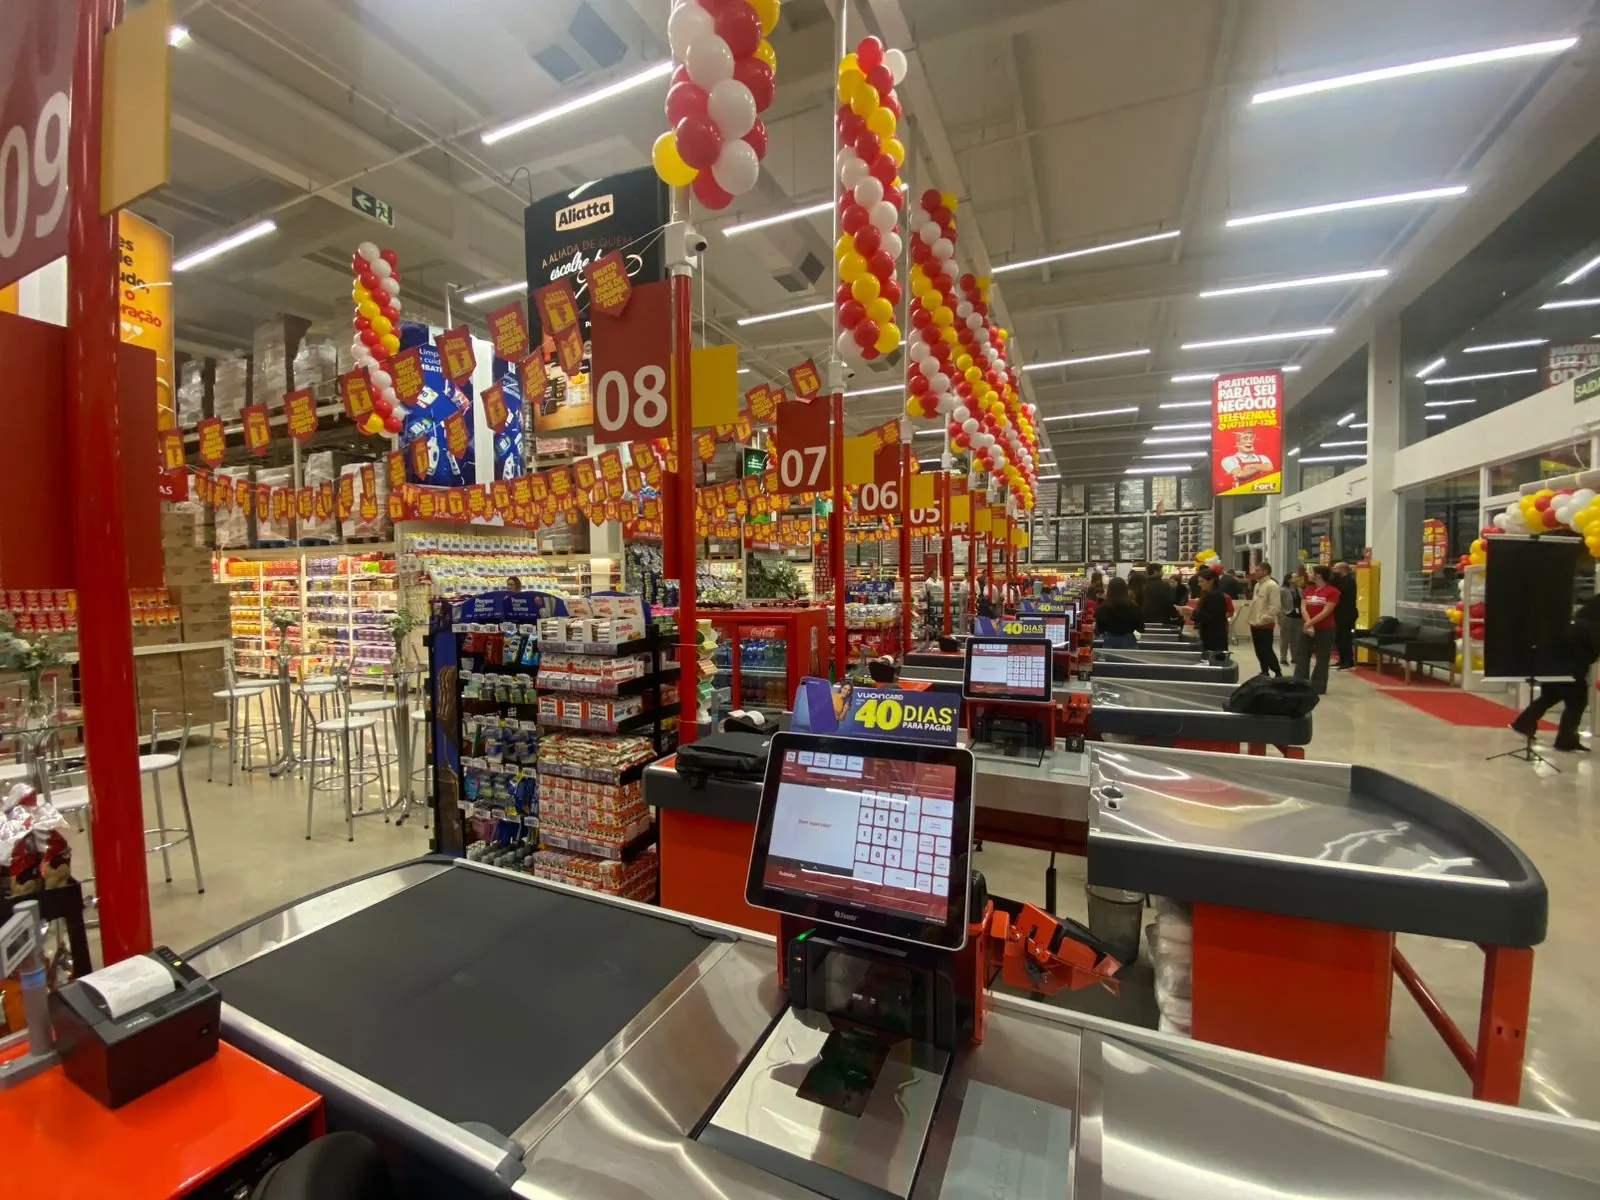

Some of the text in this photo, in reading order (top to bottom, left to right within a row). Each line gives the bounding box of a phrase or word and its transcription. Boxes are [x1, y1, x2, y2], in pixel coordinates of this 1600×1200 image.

[0, 91, 70, 258] 09
[558, 200, 611, 229] Aliatta
[542, 258, 549, 269] A
[549, 242, 582, 266] ALIADA
[582, 238, 597, 251] DE
[599, 234, 634, 248] QUEM
[593, 262, 616, 280] MUITO
[597, 271, 617, 285] MAIS
[595, 282, 613, 295] DIAS
[596, 283, 628, 303] COMPRA
[1218, 375, 1277, 389] PRATICIDADE
[596, 364, 668, 432] 08
[1218, 384, 1277, 400] PARA SEU
[1218, 397, 1277, 413] NEGÓCIO
[1218, 409, 1277, 423] TELEVENDAS
[780, 446, 827, 488] 07
[861, 481, 898, 511] 06
[750, 627, 776, 638] Coca-Cola
[1002, 622, 1044, 635] 40 DIAS
[854, 699, 902, 731] 40
[902, 721, 952, 732] PARA PAGAR
